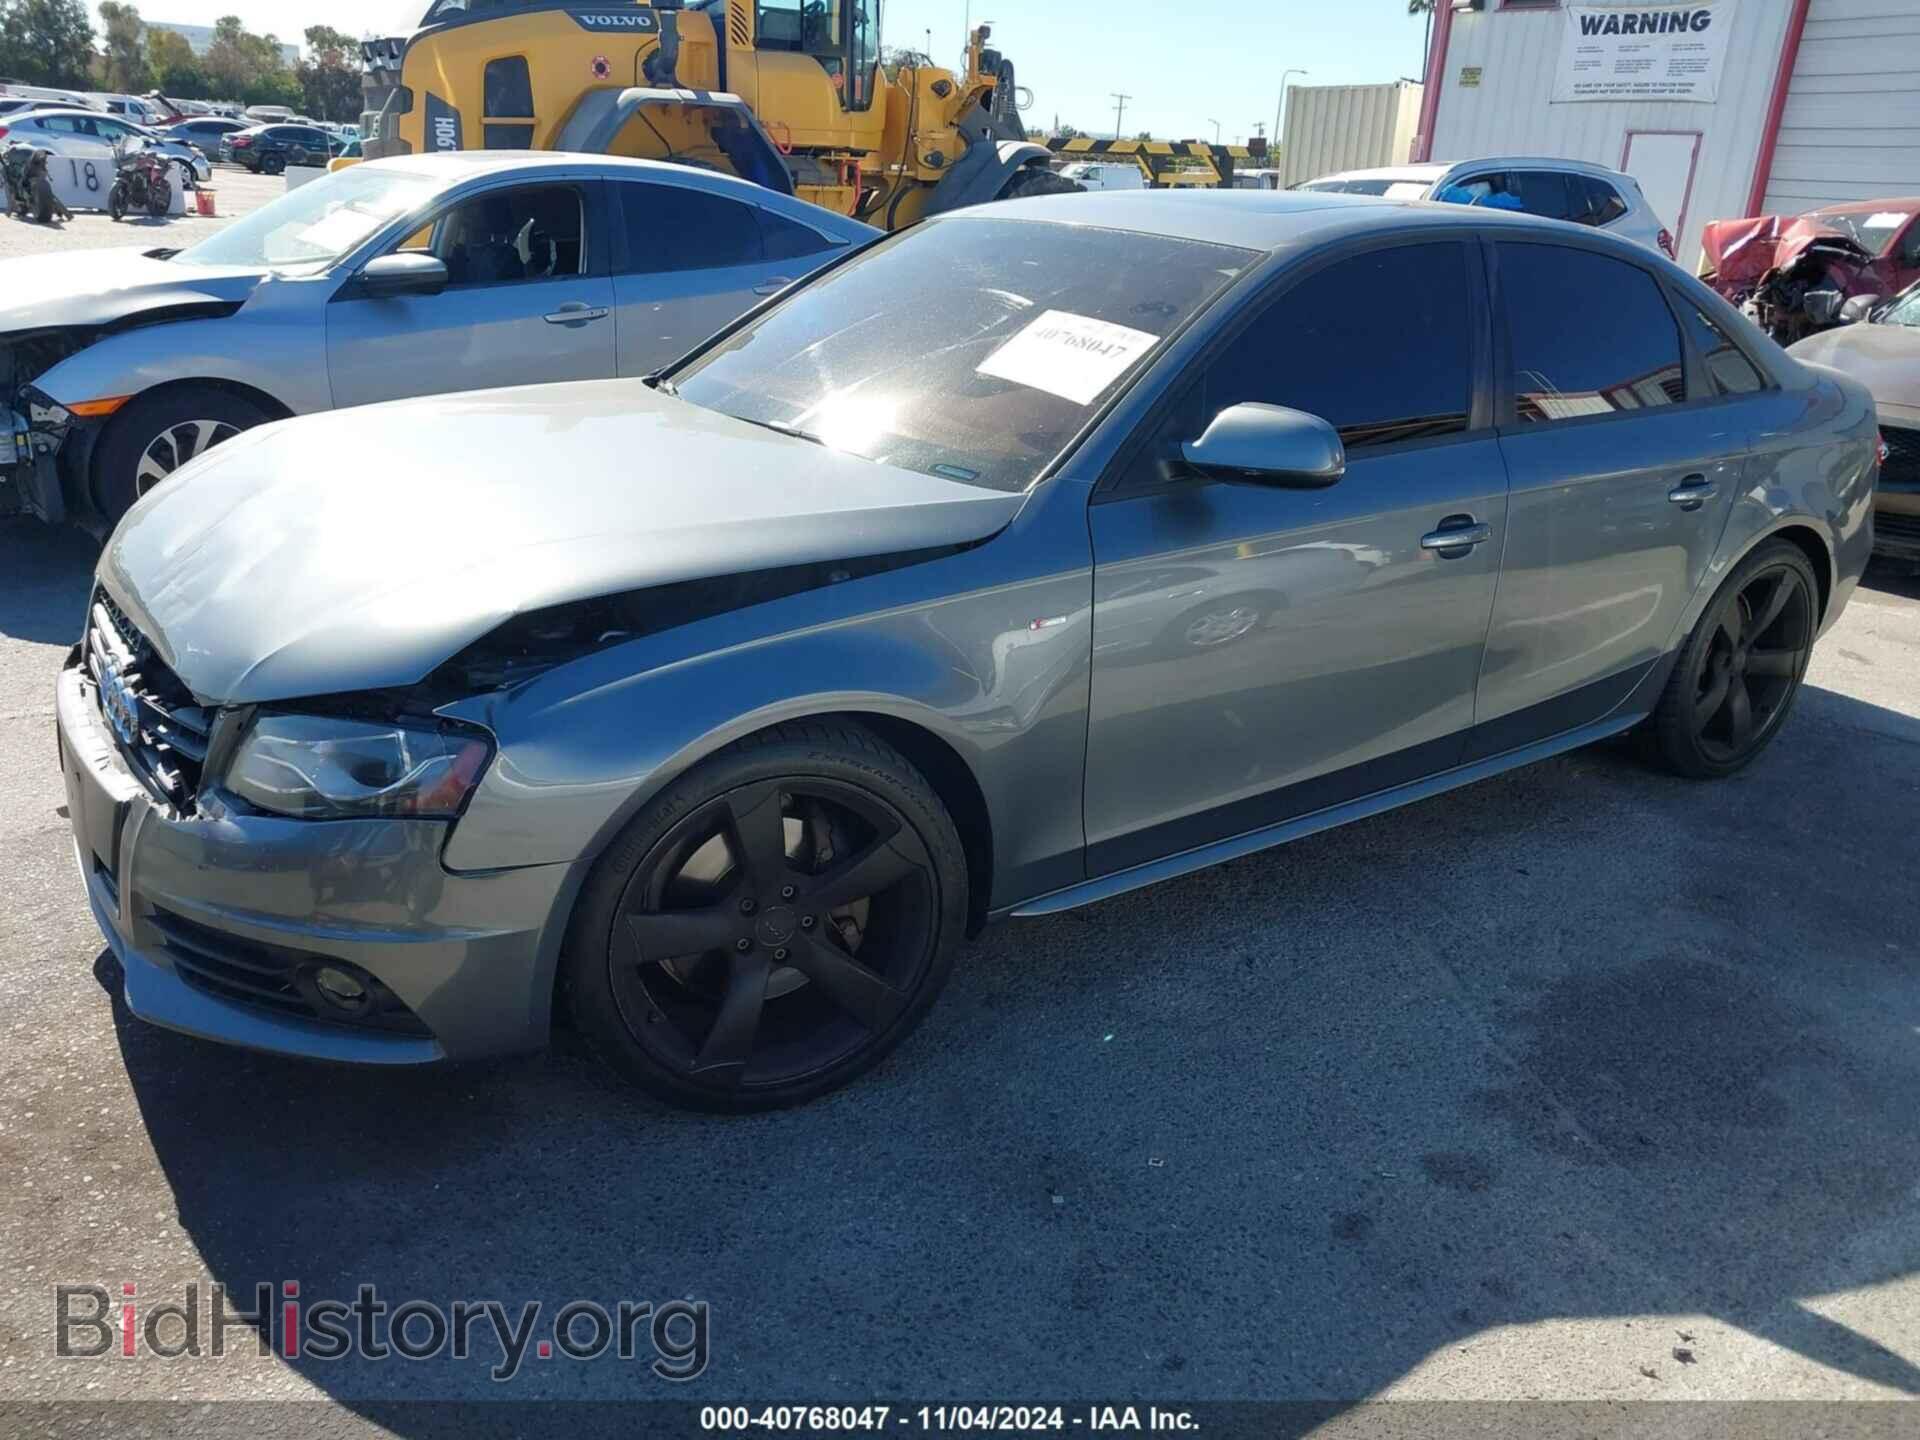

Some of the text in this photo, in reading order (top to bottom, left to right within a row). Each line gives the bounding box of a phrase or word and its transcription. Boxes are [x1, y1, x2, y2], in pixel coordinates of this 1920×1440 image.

[580, 15, 651, 26] VOLVO
[1580, 9, 1711, 36] WARNING
[434, 117, 457, 151] 90H
[70, 159, 99, 192] 18
